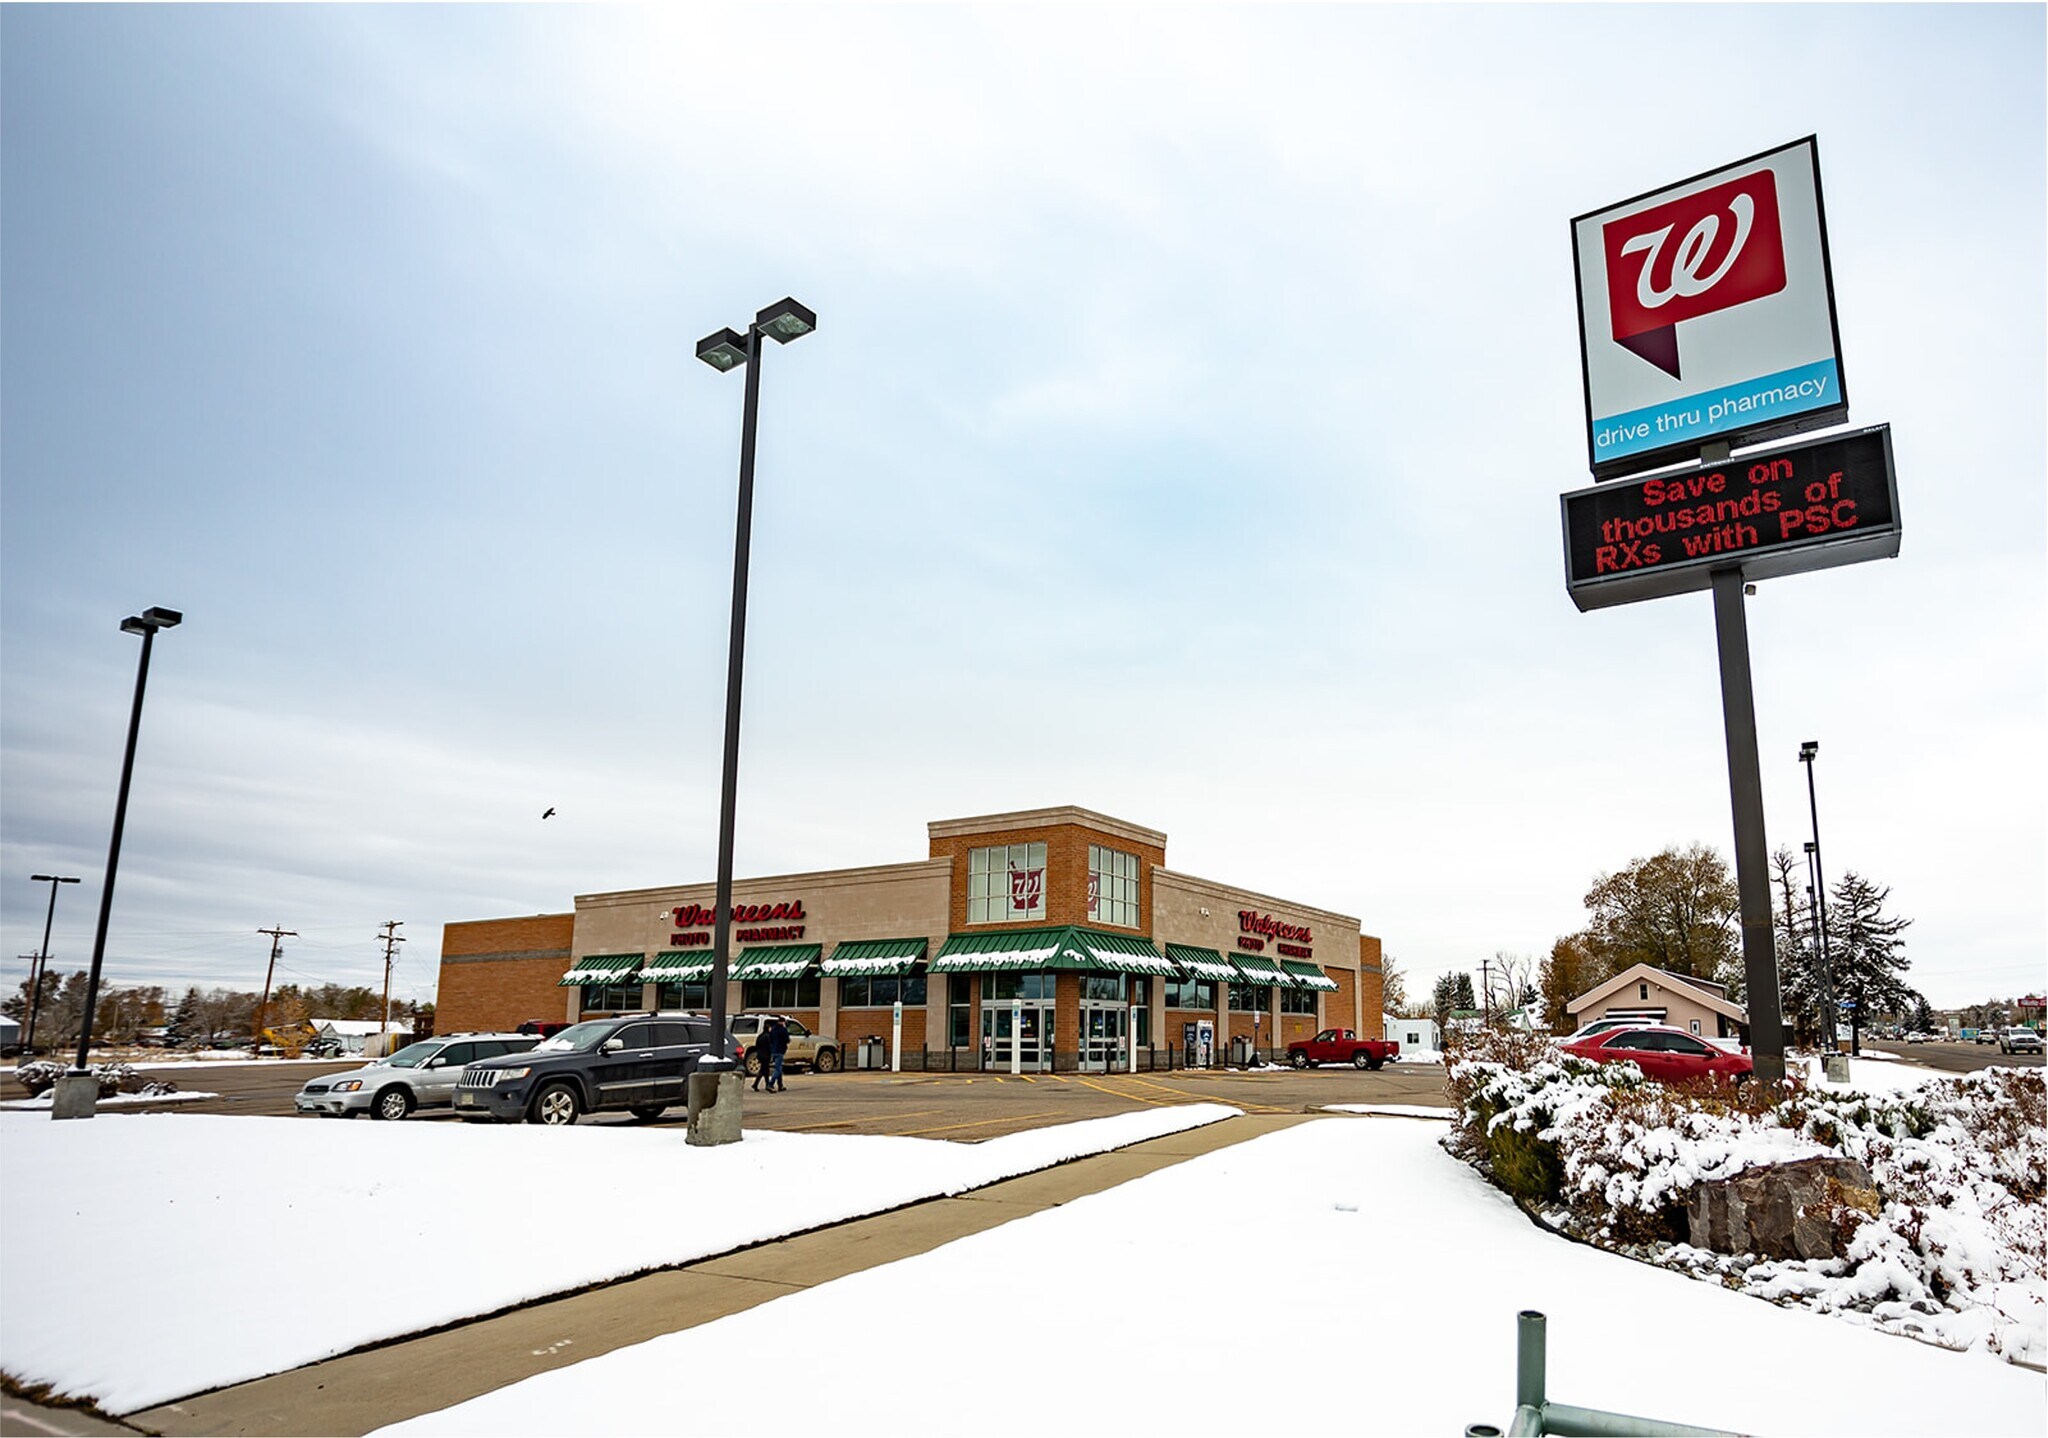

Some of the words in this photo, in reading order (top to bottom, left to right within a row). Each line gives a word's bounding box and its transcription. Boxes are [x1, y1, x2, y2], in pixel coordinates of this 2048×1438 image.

[1621, 193, 1755, 309] W
[1597, 422, 1650, 447] drive
[1656, 409, 1700, 432] thru
[1708, 376, 1828, 424] pharmacy
[1601, 489, 1782, 543] thousands
[1804, 471, 1843, 503] of
[1643, 472, 1727, 506] Save
[1748, 458, 1793, 484] on
[1595, 540, 1662, 573] RXs
[1682, 522, 1758, 556] with
[1779, 498, 1859, 539] PSC
[670, 932, 709, 946] PHOTO
[736, 925, 805, 942] PHARMACY
[1237, 910, 1313, 943] Walgreens
